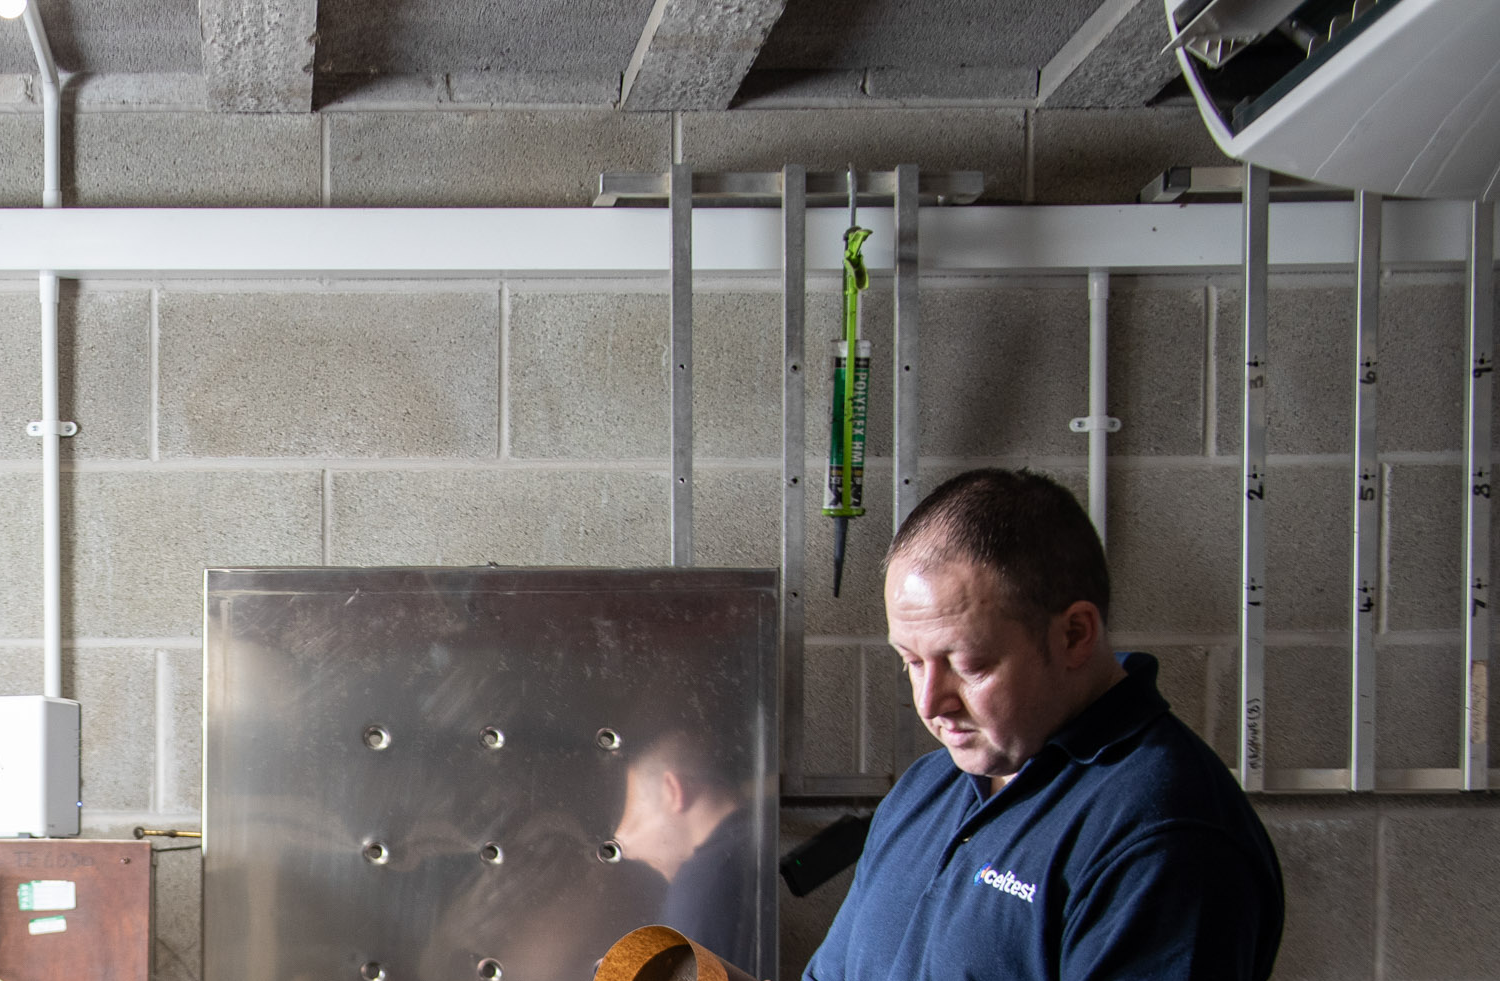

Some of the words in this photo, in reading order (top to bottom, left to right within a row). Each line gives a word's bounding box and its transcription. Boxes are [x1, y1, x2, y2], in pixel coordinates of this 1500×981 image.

[851, 441, 864, 464] HM
[1247, 482, 1264, 500] 2
[1359, 485, 1375, 501] 5
[1472, 483, 1491, 499] 8
[1359, 596, 1375, 613] 4
[1472, 598, 1486, 617] 7
